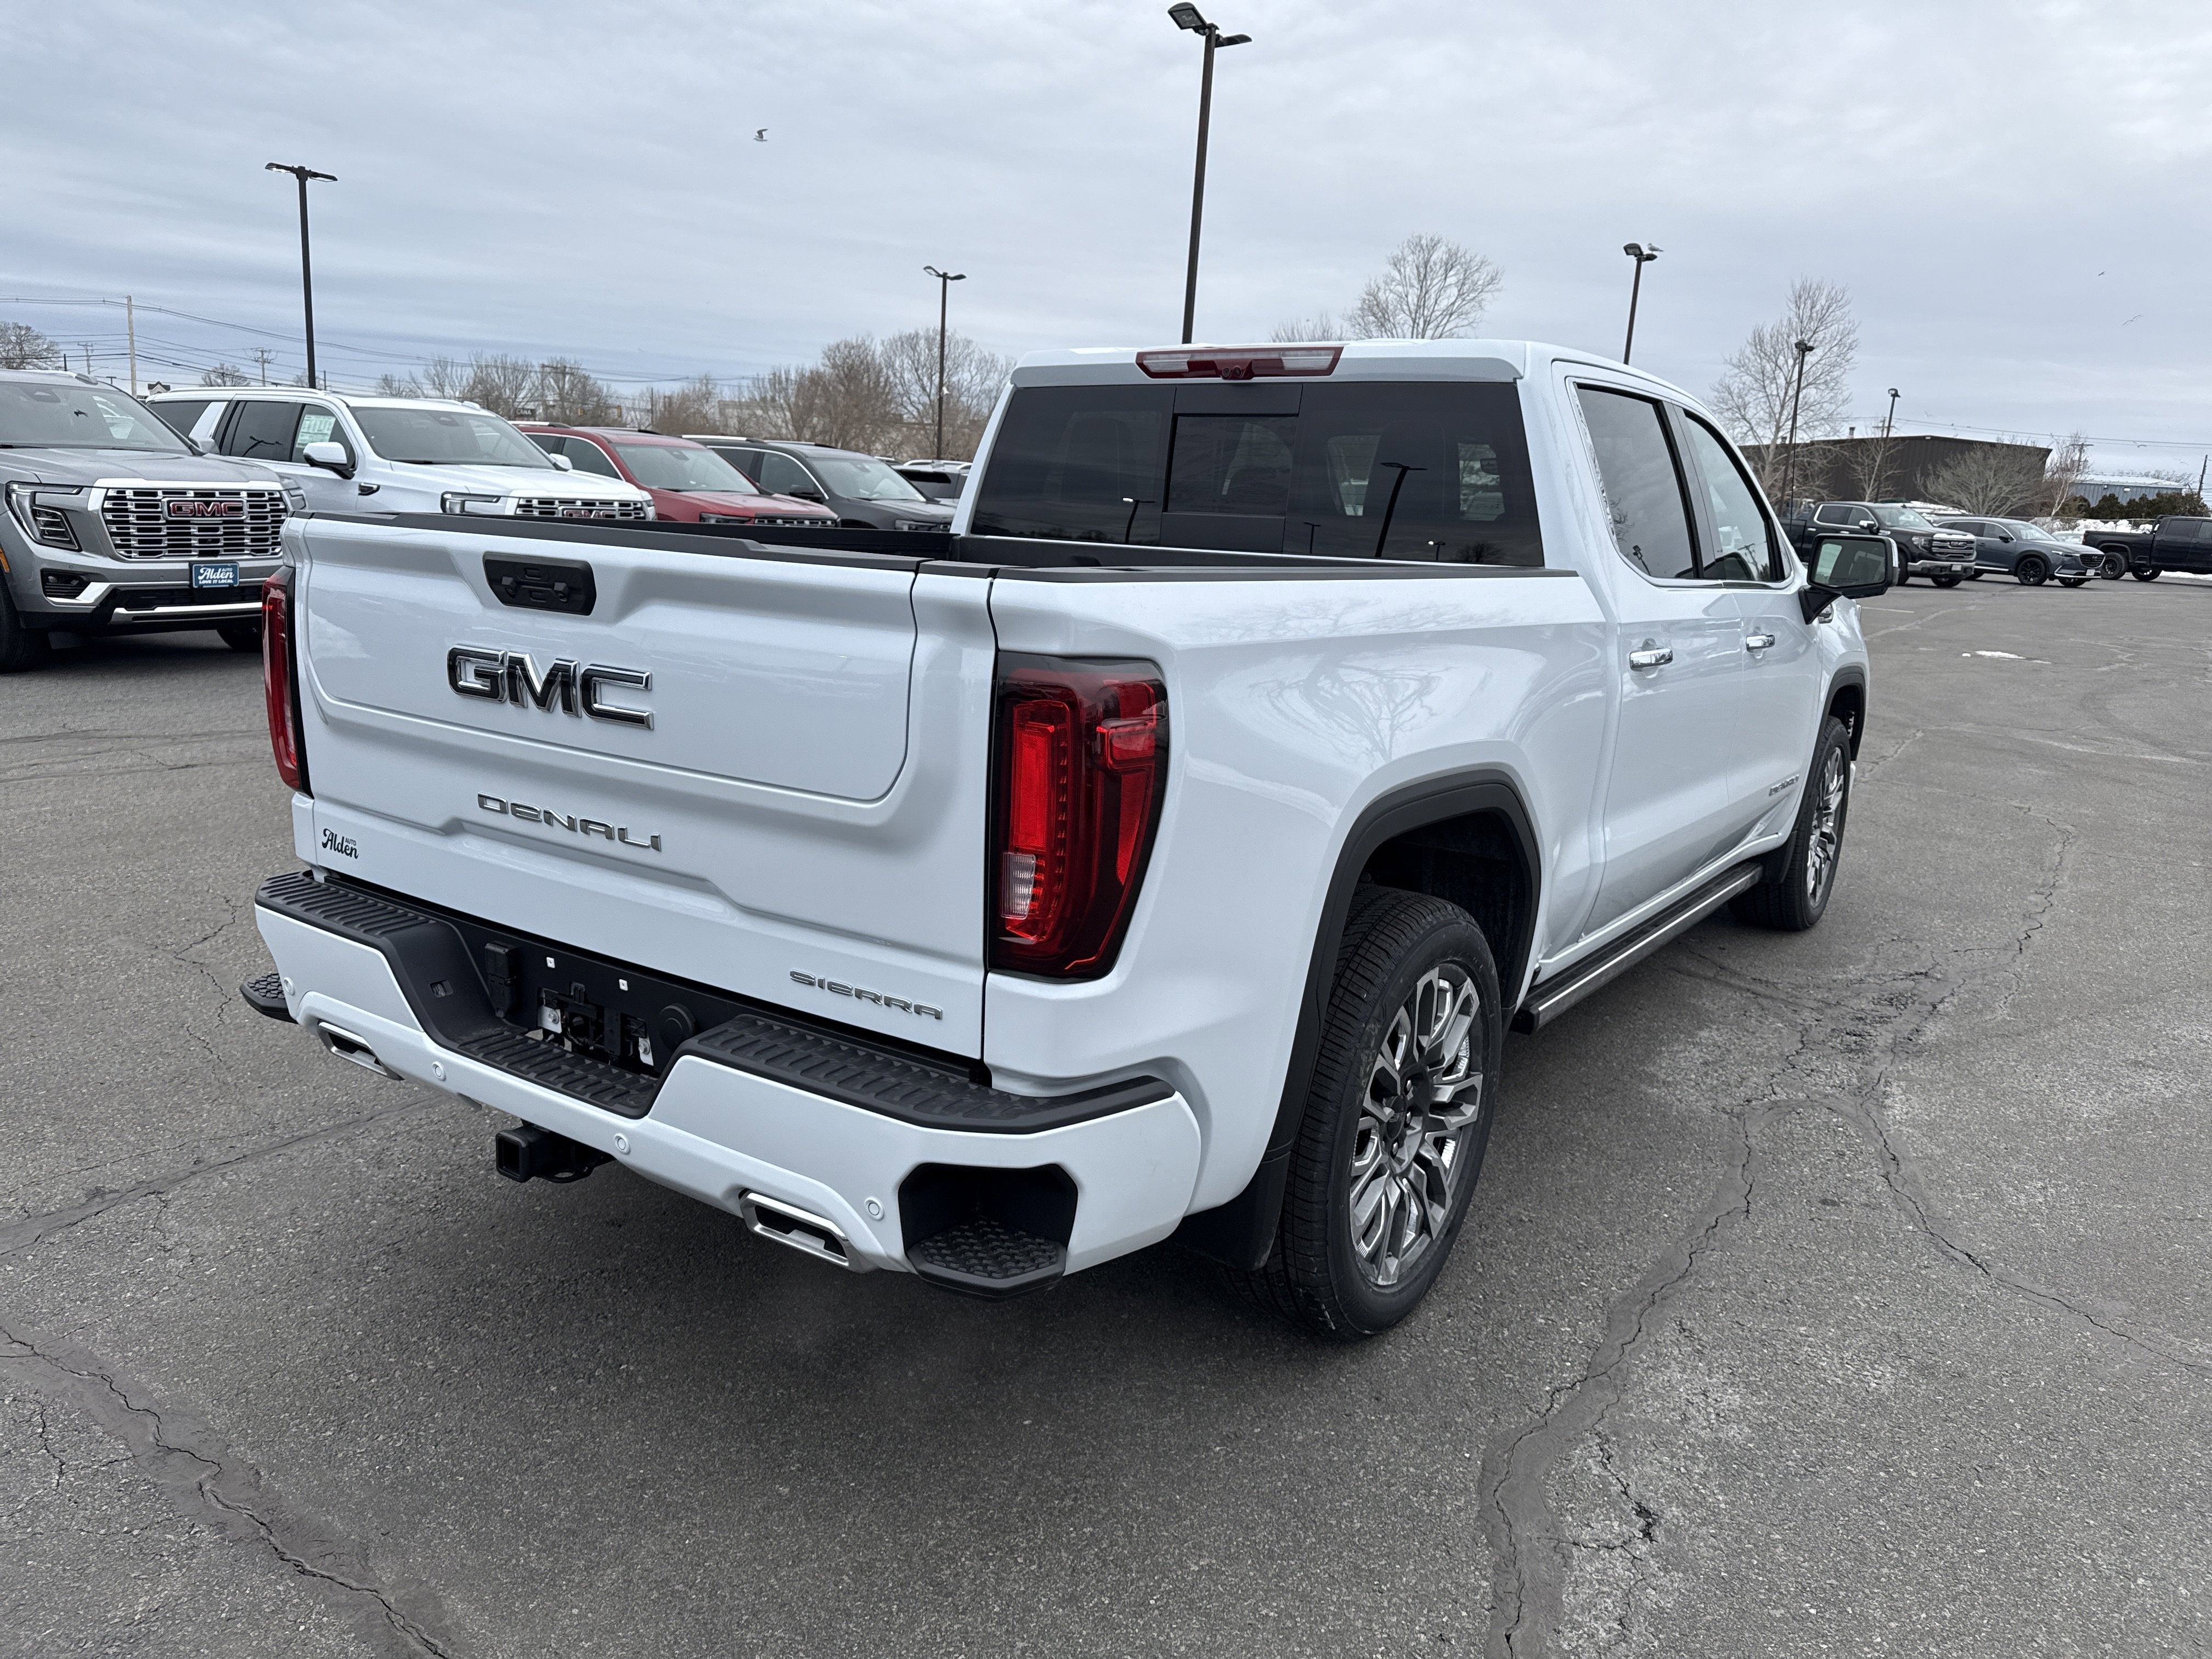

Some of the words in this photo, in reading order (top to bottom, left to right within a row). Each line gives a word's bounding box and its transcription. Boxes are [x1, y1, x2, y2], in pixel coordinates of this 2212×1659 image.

[170, 502, 244, 516] GMC
[198, 567, 234, 580] Alden
[447, 643, 655, 730] GMC
[477, 792, 662, 851] DENALI
[321, 828, 359, 860] Alden
[345, 837, 357, 846] AUTO
[789, 969, 943, 1020] SIERRA
